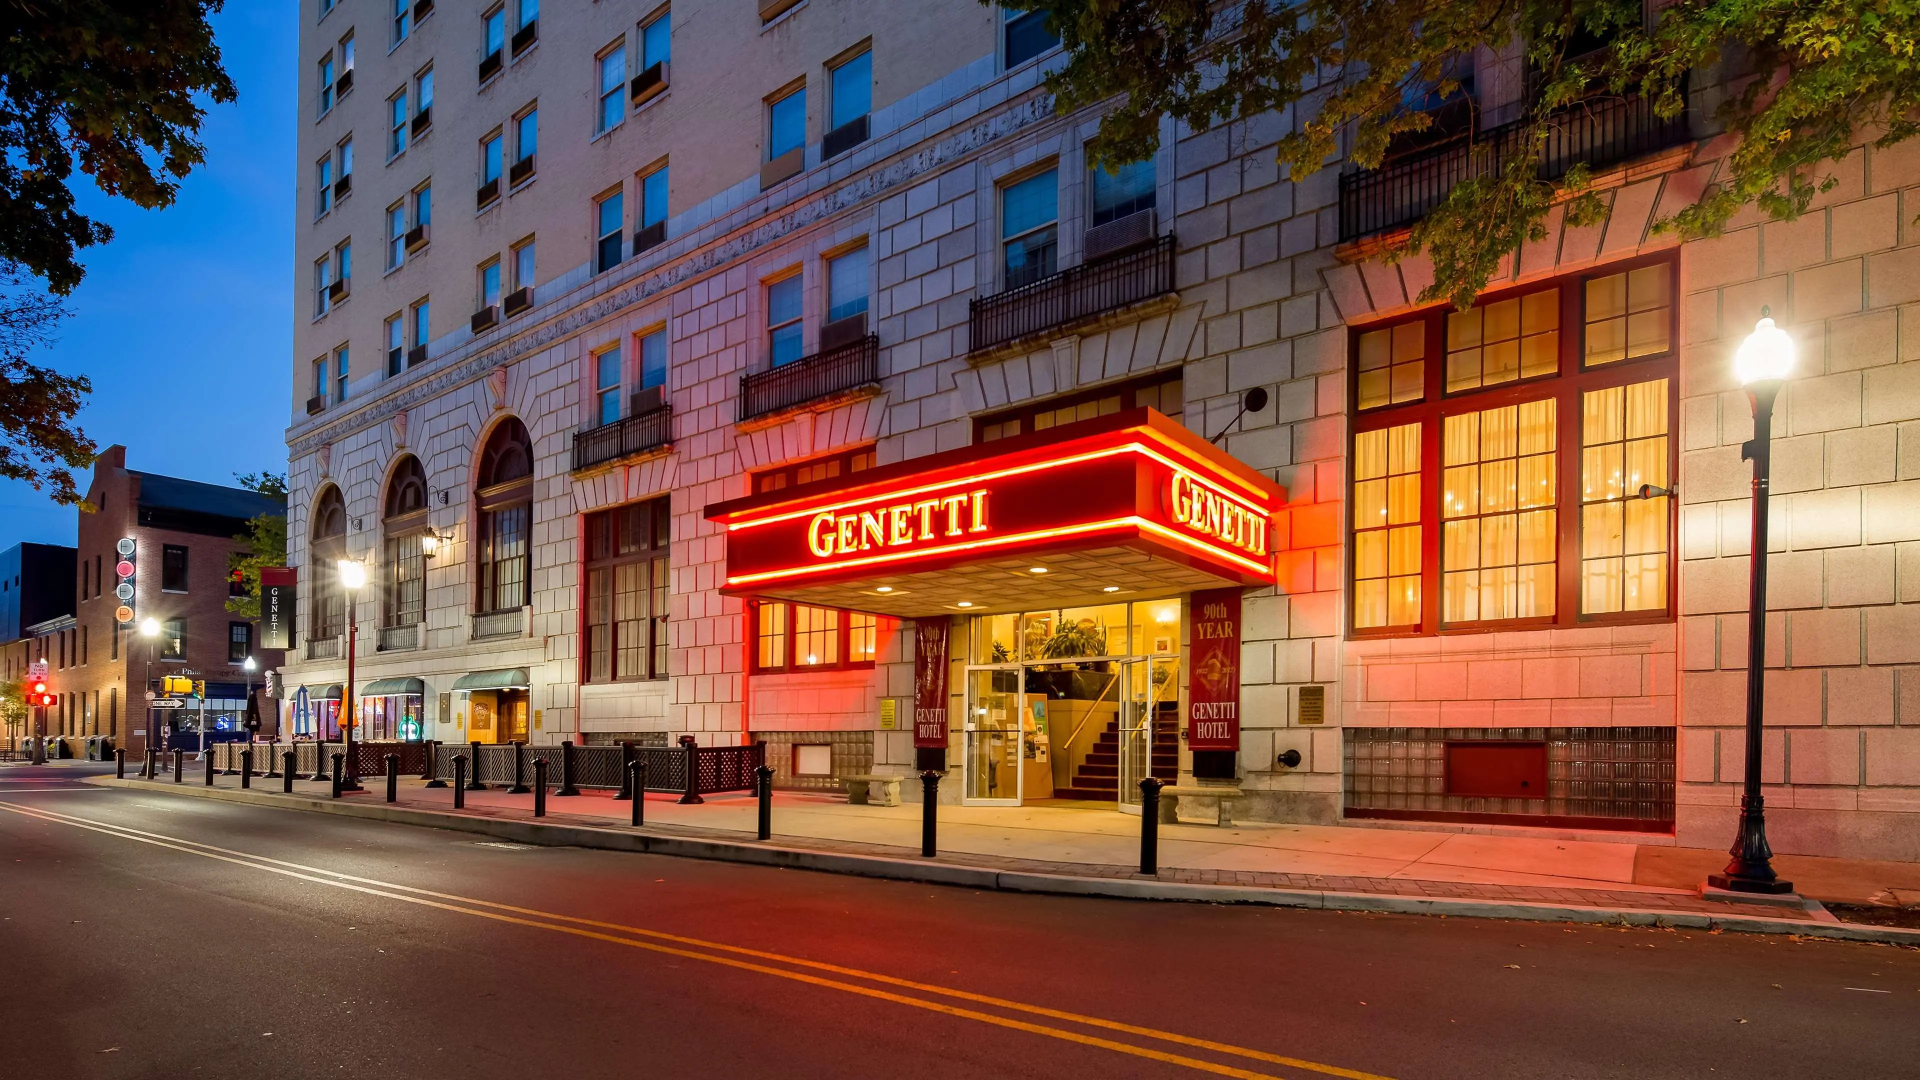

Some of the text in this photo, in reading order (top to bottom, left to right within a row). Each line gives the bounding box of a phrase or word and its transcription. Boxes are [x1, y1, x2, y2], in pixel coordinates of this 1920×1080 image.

[1171, 470, 1266, 556] GENETTI
[808, 489, 988, 557] GENETTI
[271, 587, 279, 646] GENETTI
[1203, 603, 1228, 619] 90th
[924, 626, 940, 640] 90th
[1197, 621, 1234, 640] YEAR
[921, 641, 945, 657] YEAR
[916, 708, 946, 723] GENETTI
[1192, 702, 1236, 720] GENETTI
[919, 725, 942, 739] HOTEL
[1197, 722, 1231, 739] HOTEL
